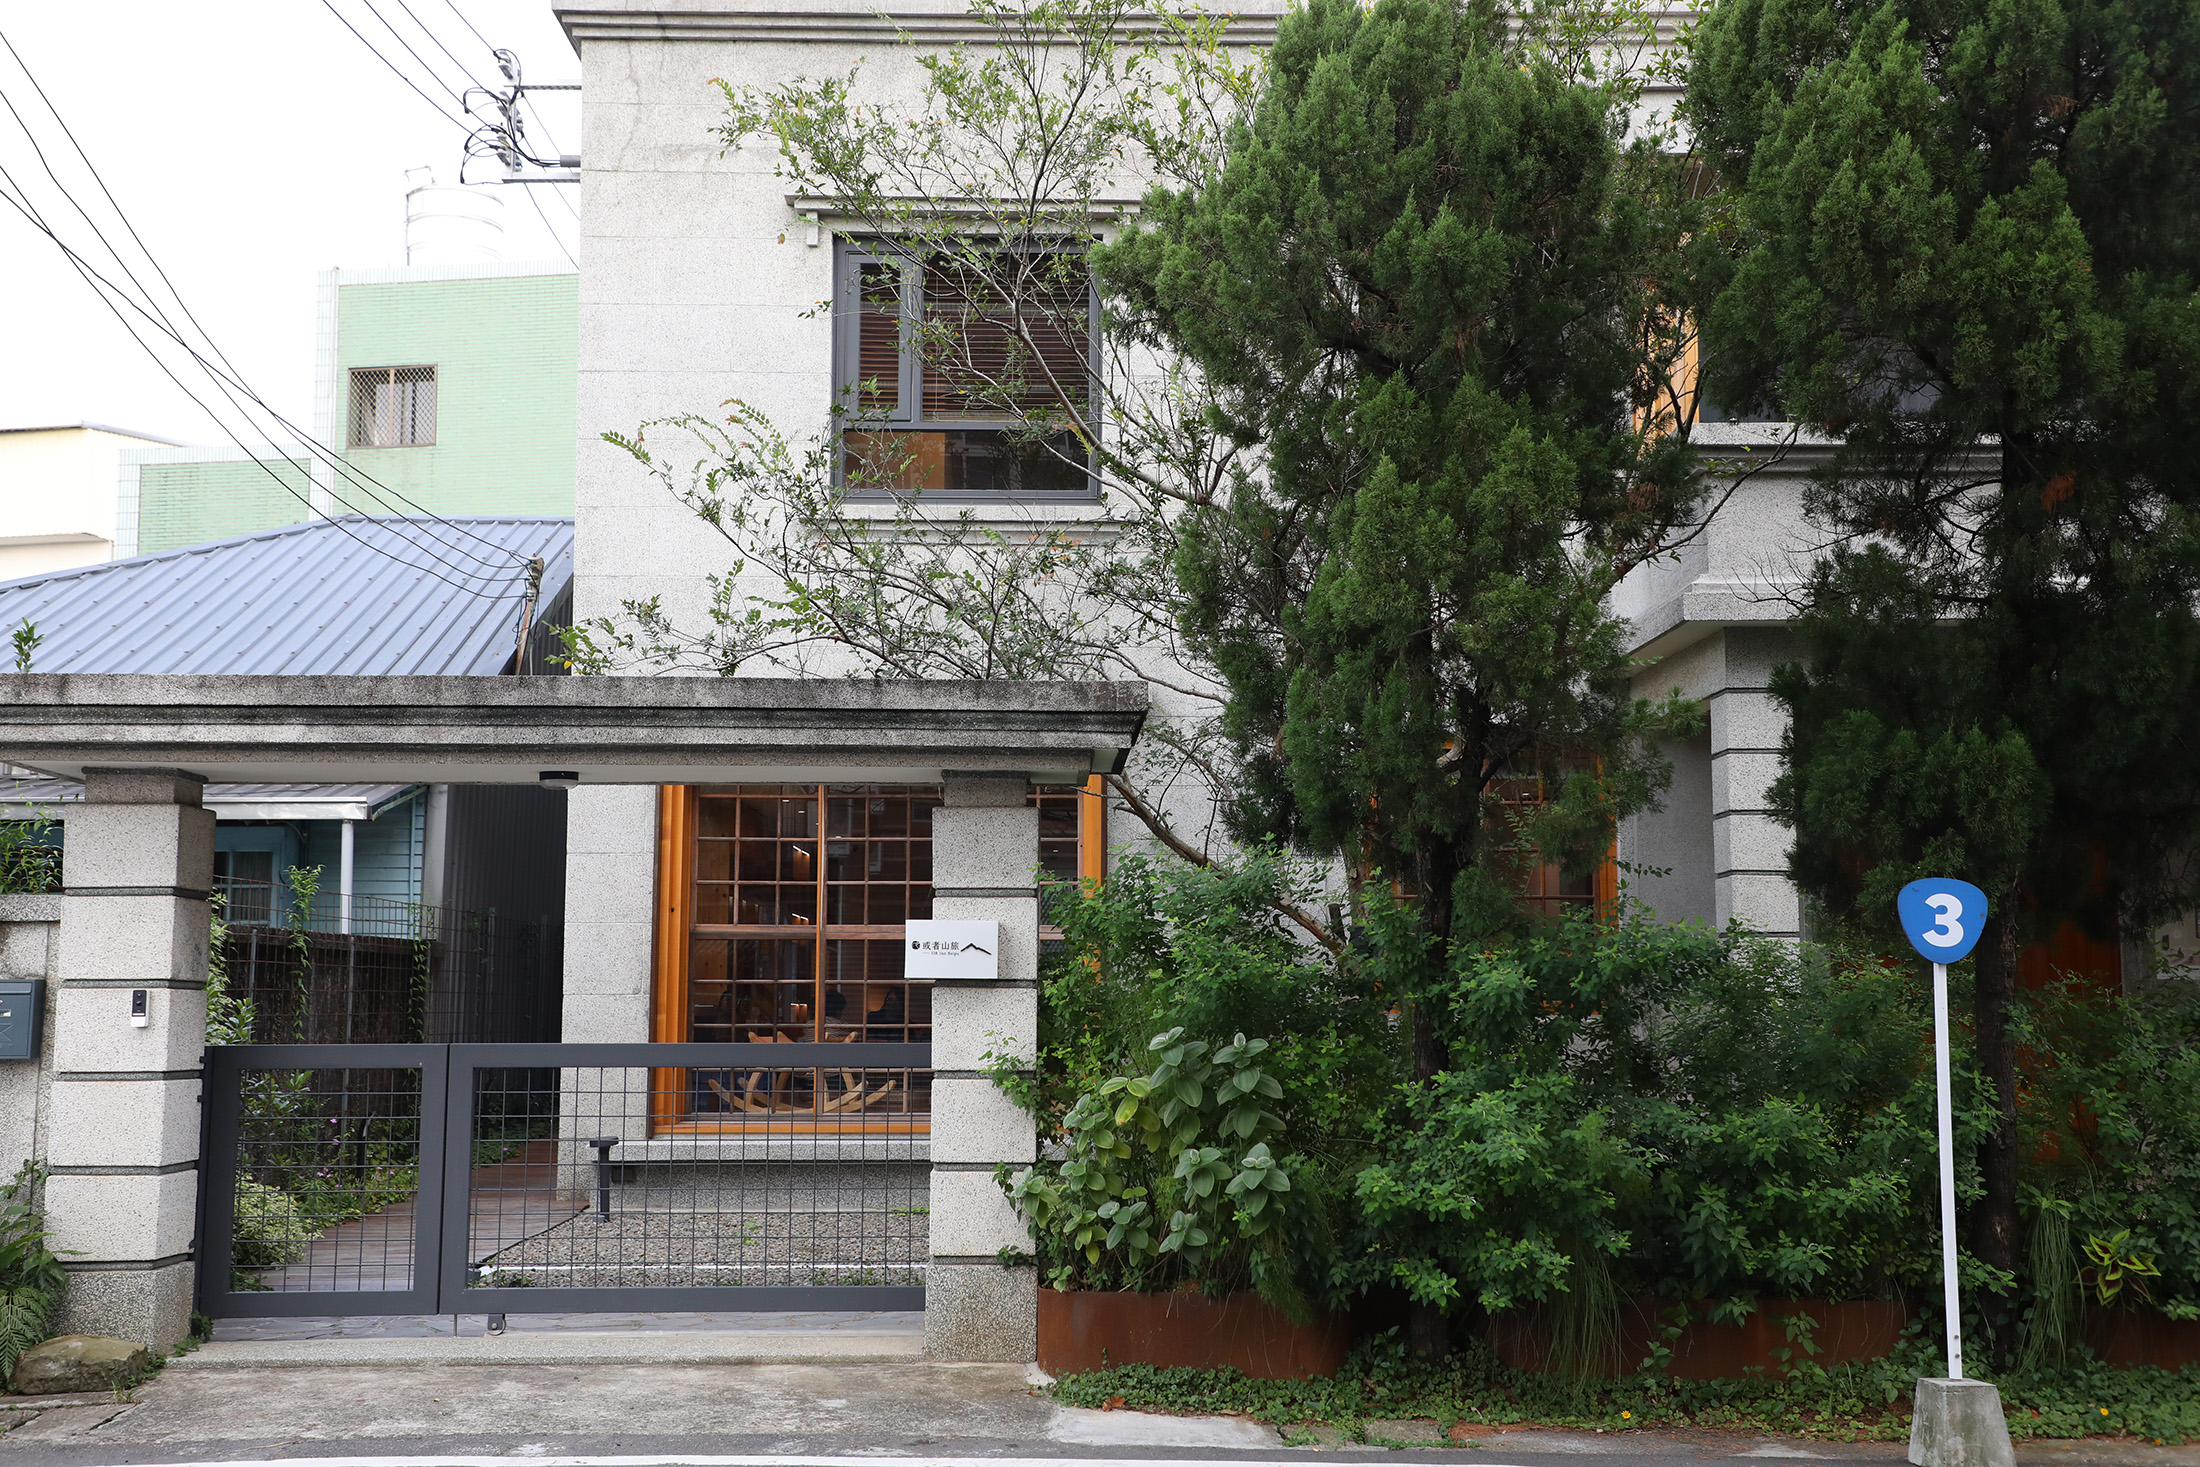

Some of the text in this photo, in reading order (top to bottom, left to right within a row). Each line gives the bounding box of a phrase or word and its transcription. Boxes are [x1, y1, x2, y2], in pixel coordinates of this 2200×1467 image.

[1922, 893, 1964, 948] 3
[922, 942, 960, 950] 或者山旅
